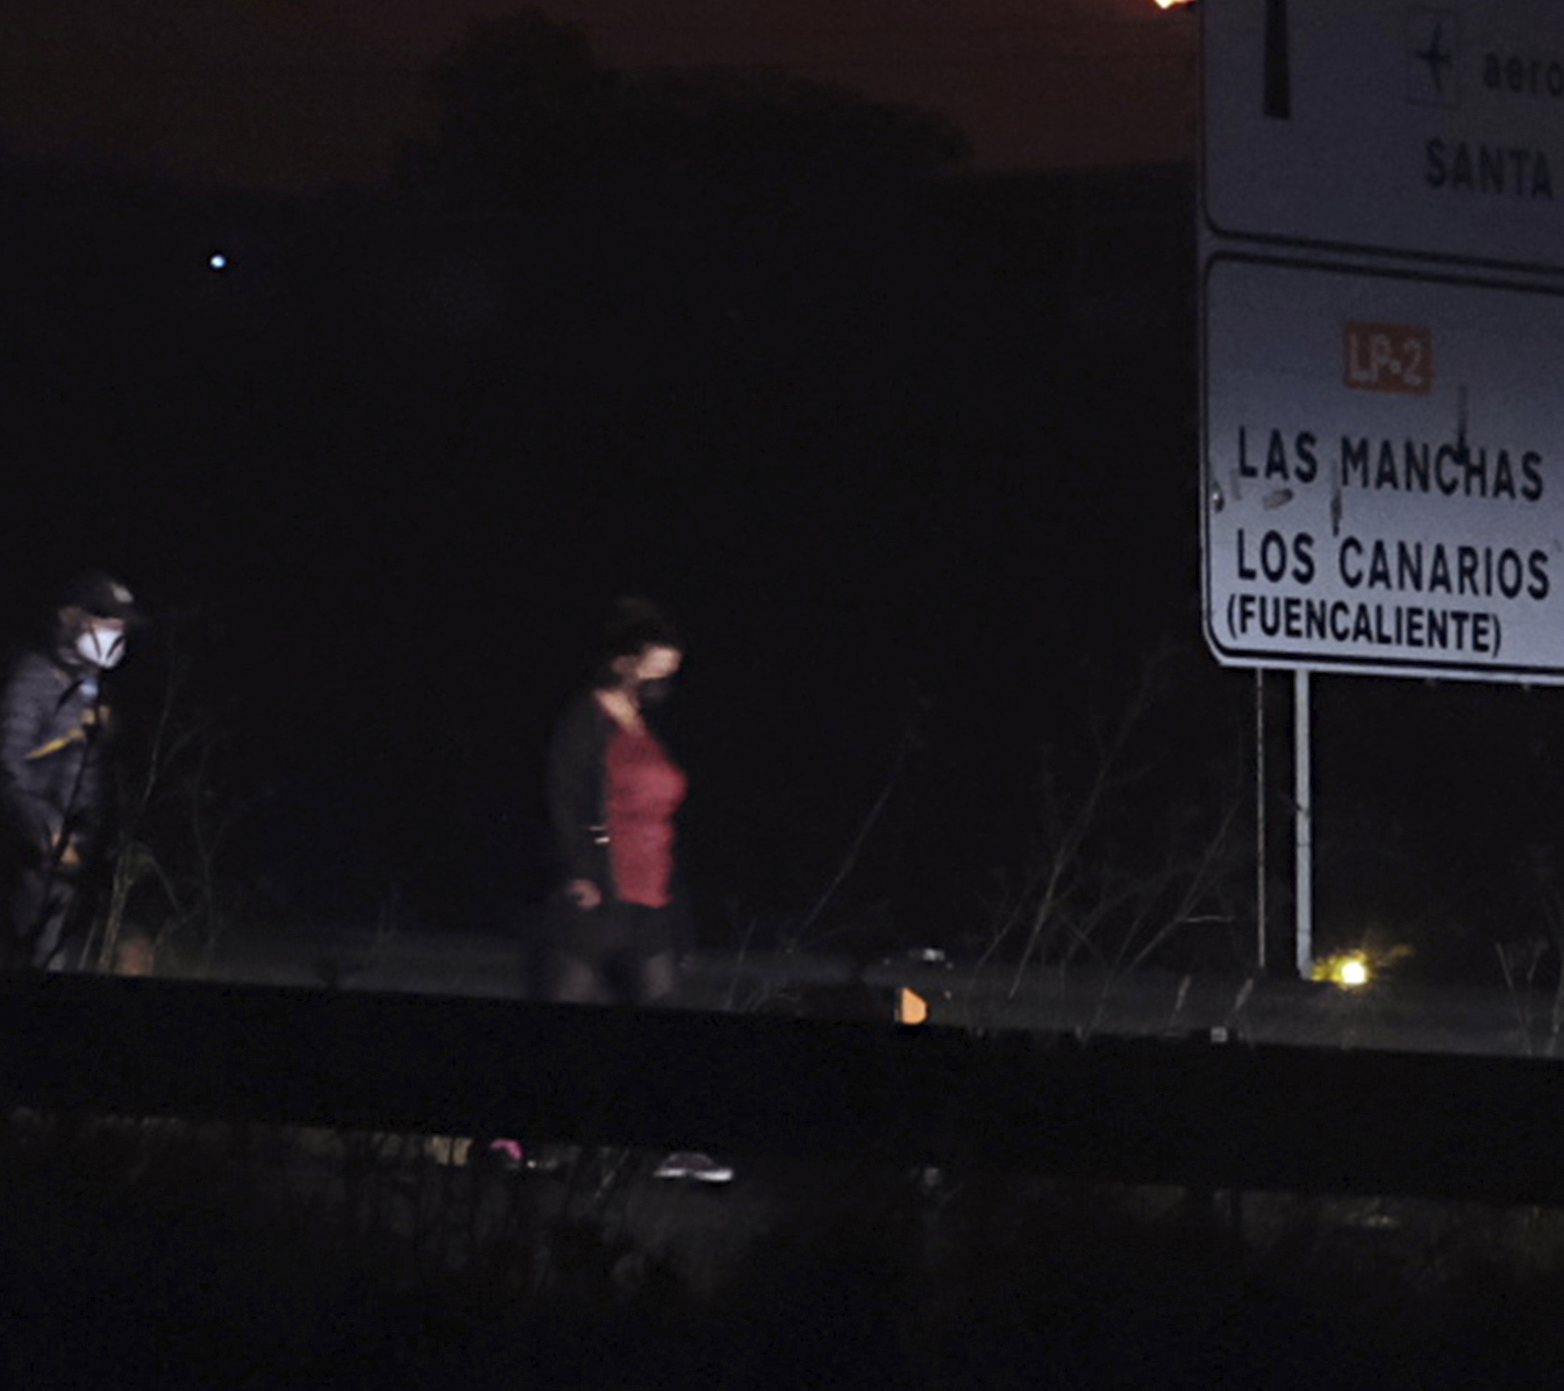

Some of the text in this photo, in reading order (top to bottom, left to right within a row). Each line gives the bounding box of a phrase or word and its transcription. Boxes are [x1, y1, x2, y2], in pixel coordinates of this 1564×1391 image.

[1425, 137, 1554, 201] SANTA
[1348, 332, 1424, 389] LP-2
[1238, 425, 1544, 502] LAS MANCHAS
[1237, 528, 1550, 601] LOS CANARIOS
[1227, 594, 1502, 657] (FUENCALIENTE)
